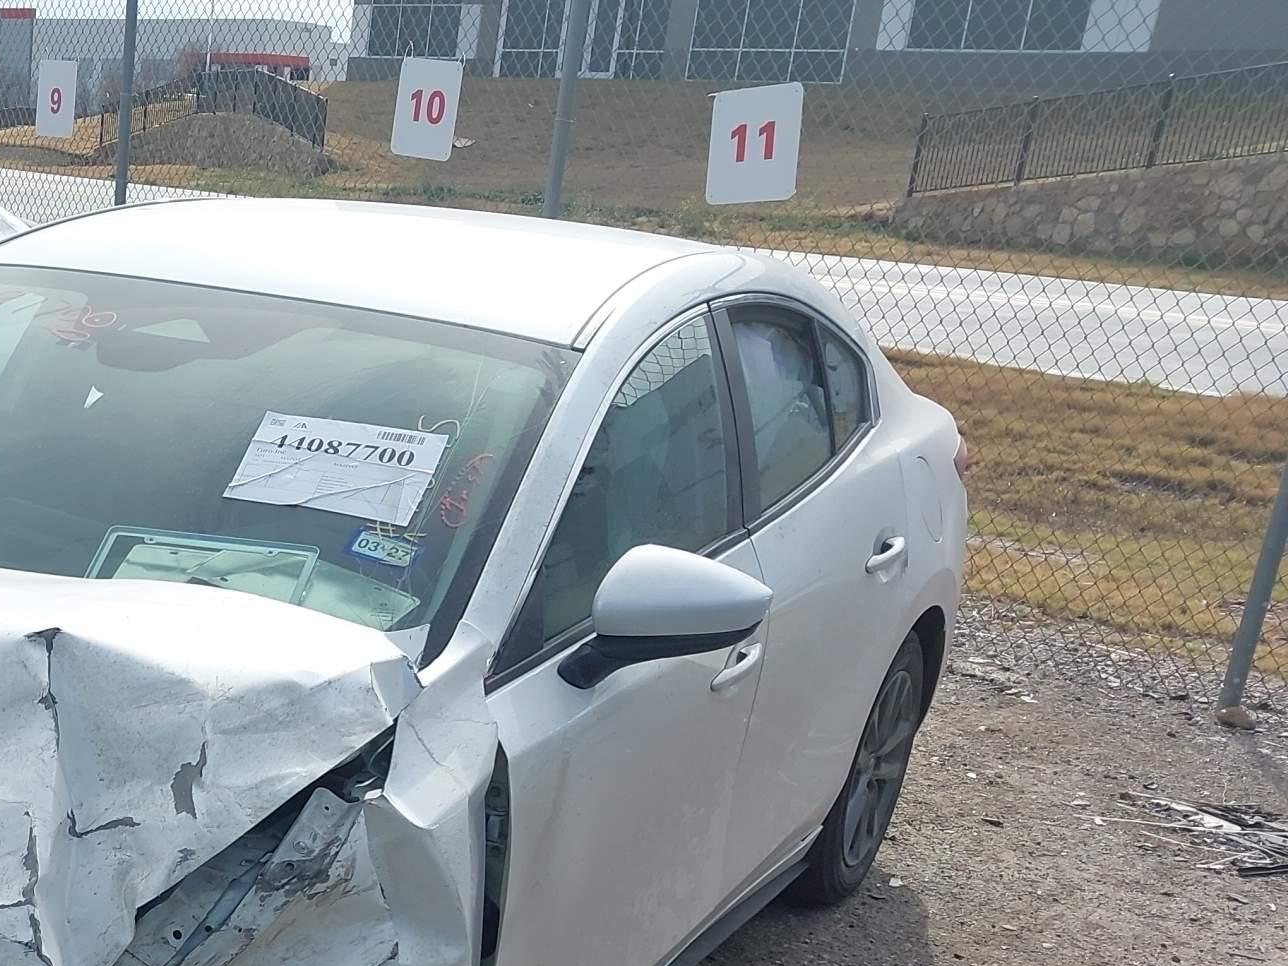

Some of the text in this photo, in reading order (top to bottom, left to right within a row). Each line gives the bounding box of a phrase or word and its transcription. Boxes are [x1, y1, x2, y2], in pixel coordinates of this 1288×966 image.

[49, 87, 63, 114] 9
[410, 88, 447, 126] 10
[730, 120, 777, 163] 11
[271, 434, 415, 467] 44087700
[357, 538, 410, 561] 03 27
